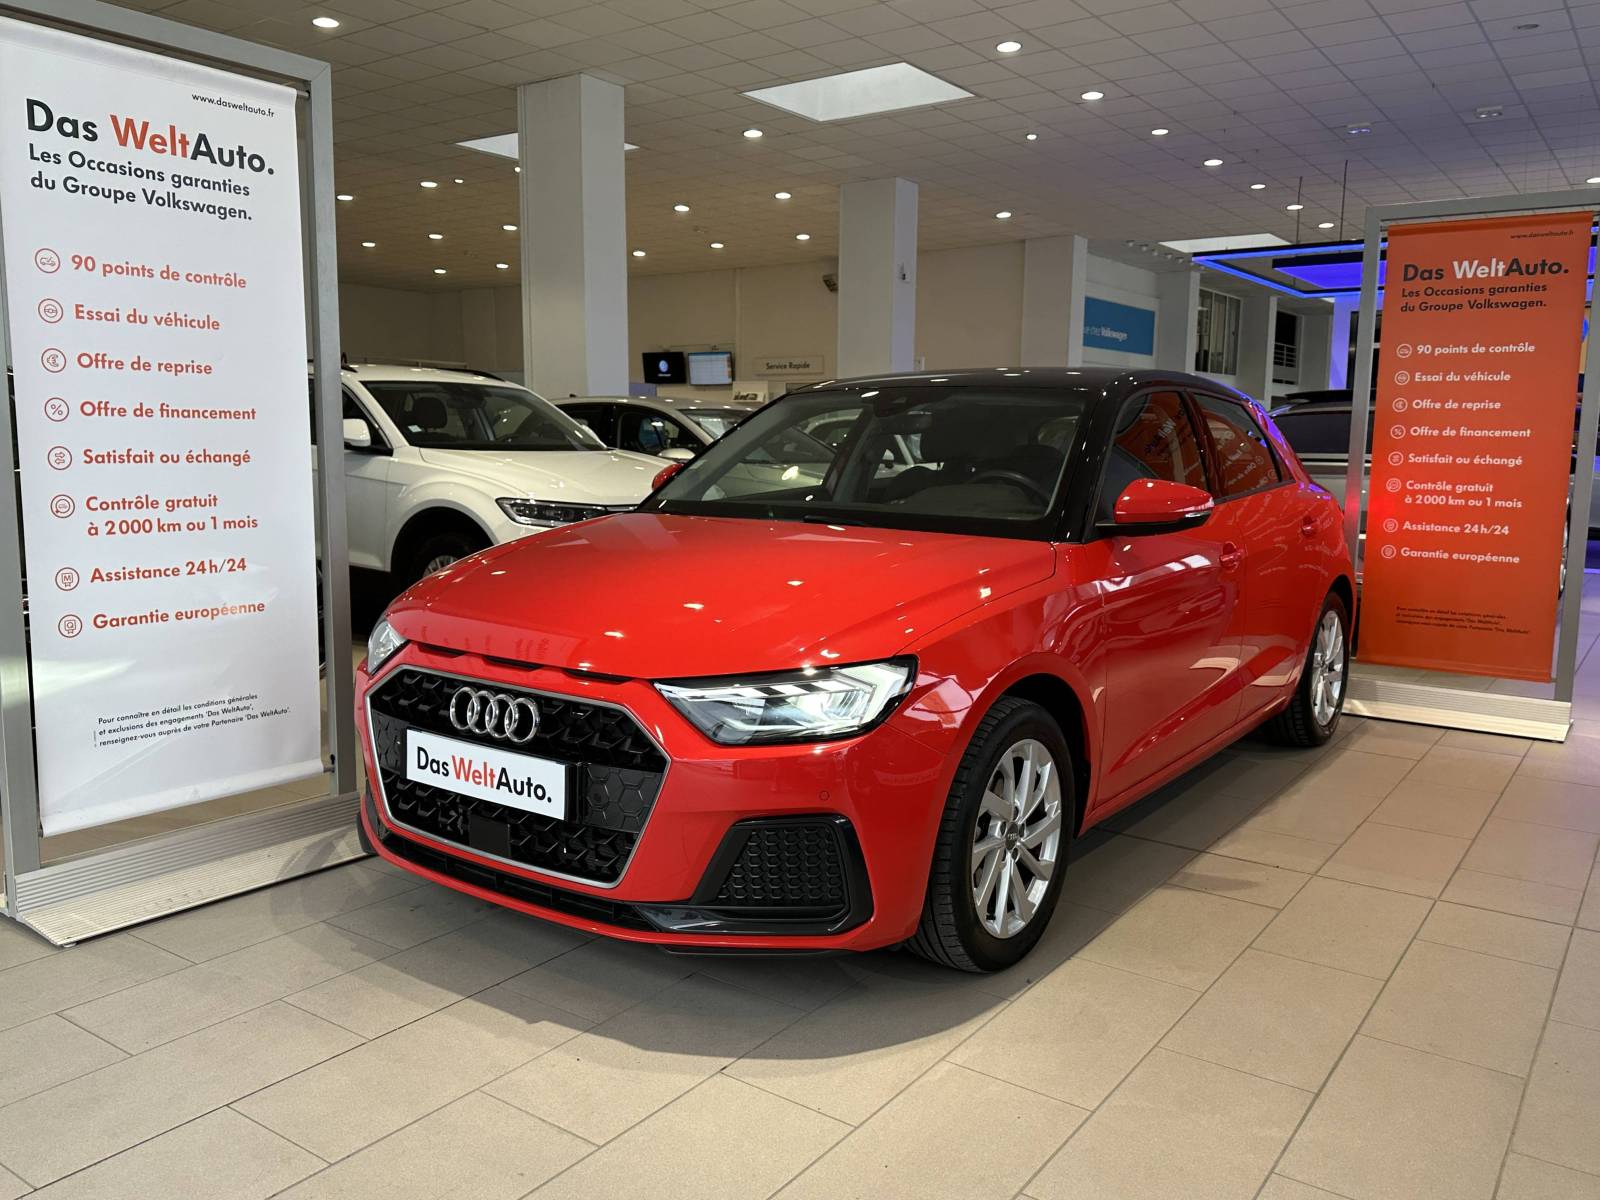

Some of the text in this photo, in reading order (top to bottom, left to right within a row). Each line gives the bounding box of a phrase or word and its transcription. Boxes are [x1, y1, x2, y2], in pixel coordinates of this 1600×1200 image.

[192, 92, 274, 117] www.dasweltauto.fr
[26, 98, 274, 175] Das WeltAuto.
[29, 143, 250, 196] Les Occasions garanties
[30, 172, 252, 221] du Groupe Volkswagen.
[72, 255, 246, 288] 90 points de contrôle
[1403, 257, 1569, 282] Das WeltAuto.
[1402, 282, 1547, 298] Les Occasions garanties
[1401, 298, 1547, 312] du Groupe Volkswagen.
[75, 304, 220, 330] Essai du véhicule
[1416, 342, 1535, 356] 90 points de contrôle
[77, 352, 212, 376] Offre de reprise
[766, 361, 810, 370] Service Rapide
[1415, 371, 1511, 382] Essai du véhicule
[80, 401, 256, 420] Offre de financement
[1412, 400, 1501, 411] Offre de reprise
[1410, 427, 1531, 438] Offre de financement
[83, 449, 250, 466] Satisfait ou échangé
[1408, 454, 1523, 468] Satisfait ou échangé
[1406, 481, 1493, 494] Contrôle gratuit
[86, 494, 218, 512] Contrôle gratuit
[1404, 496, 1412, 505] à
[1448, 496, 1465, 506] km
[1468, 498, 1482, 506] ou
[1486, 497, 1491, 507] 1
[1494, 499, 1522, 508] mois
[88, 521, 99, 536] à
[157, 518, 181, 532] km
[186, 520, 206, 532] ou
[210, 516, 216, 530] 1
[223, 516, 258, 530] mois
[1403, 520, 1460, 533] Assistance
[1401, 548, 1520, 564] Garantie européenne
[90, 564, 180, 583] Assistance
[93, 602, 265, 629] Garantie européenne
[117, 711, 149, 722] connaître
[162, 706, 181, 715] détail
[194, 699, 226, 709] conditions
[228, 693, 258, 705] générales
[99, 731, 156, 747] renseignez-vous
[158, 726, 182, 737] auprès
[211, 716, 243, 727] Partenaire
[108, 722, 144, 734] exclusions
[146, 720, 158, 728] des
[160, 712, 204, 727] engagements
[417, 746, 552, 803] Das WeltAuto.
